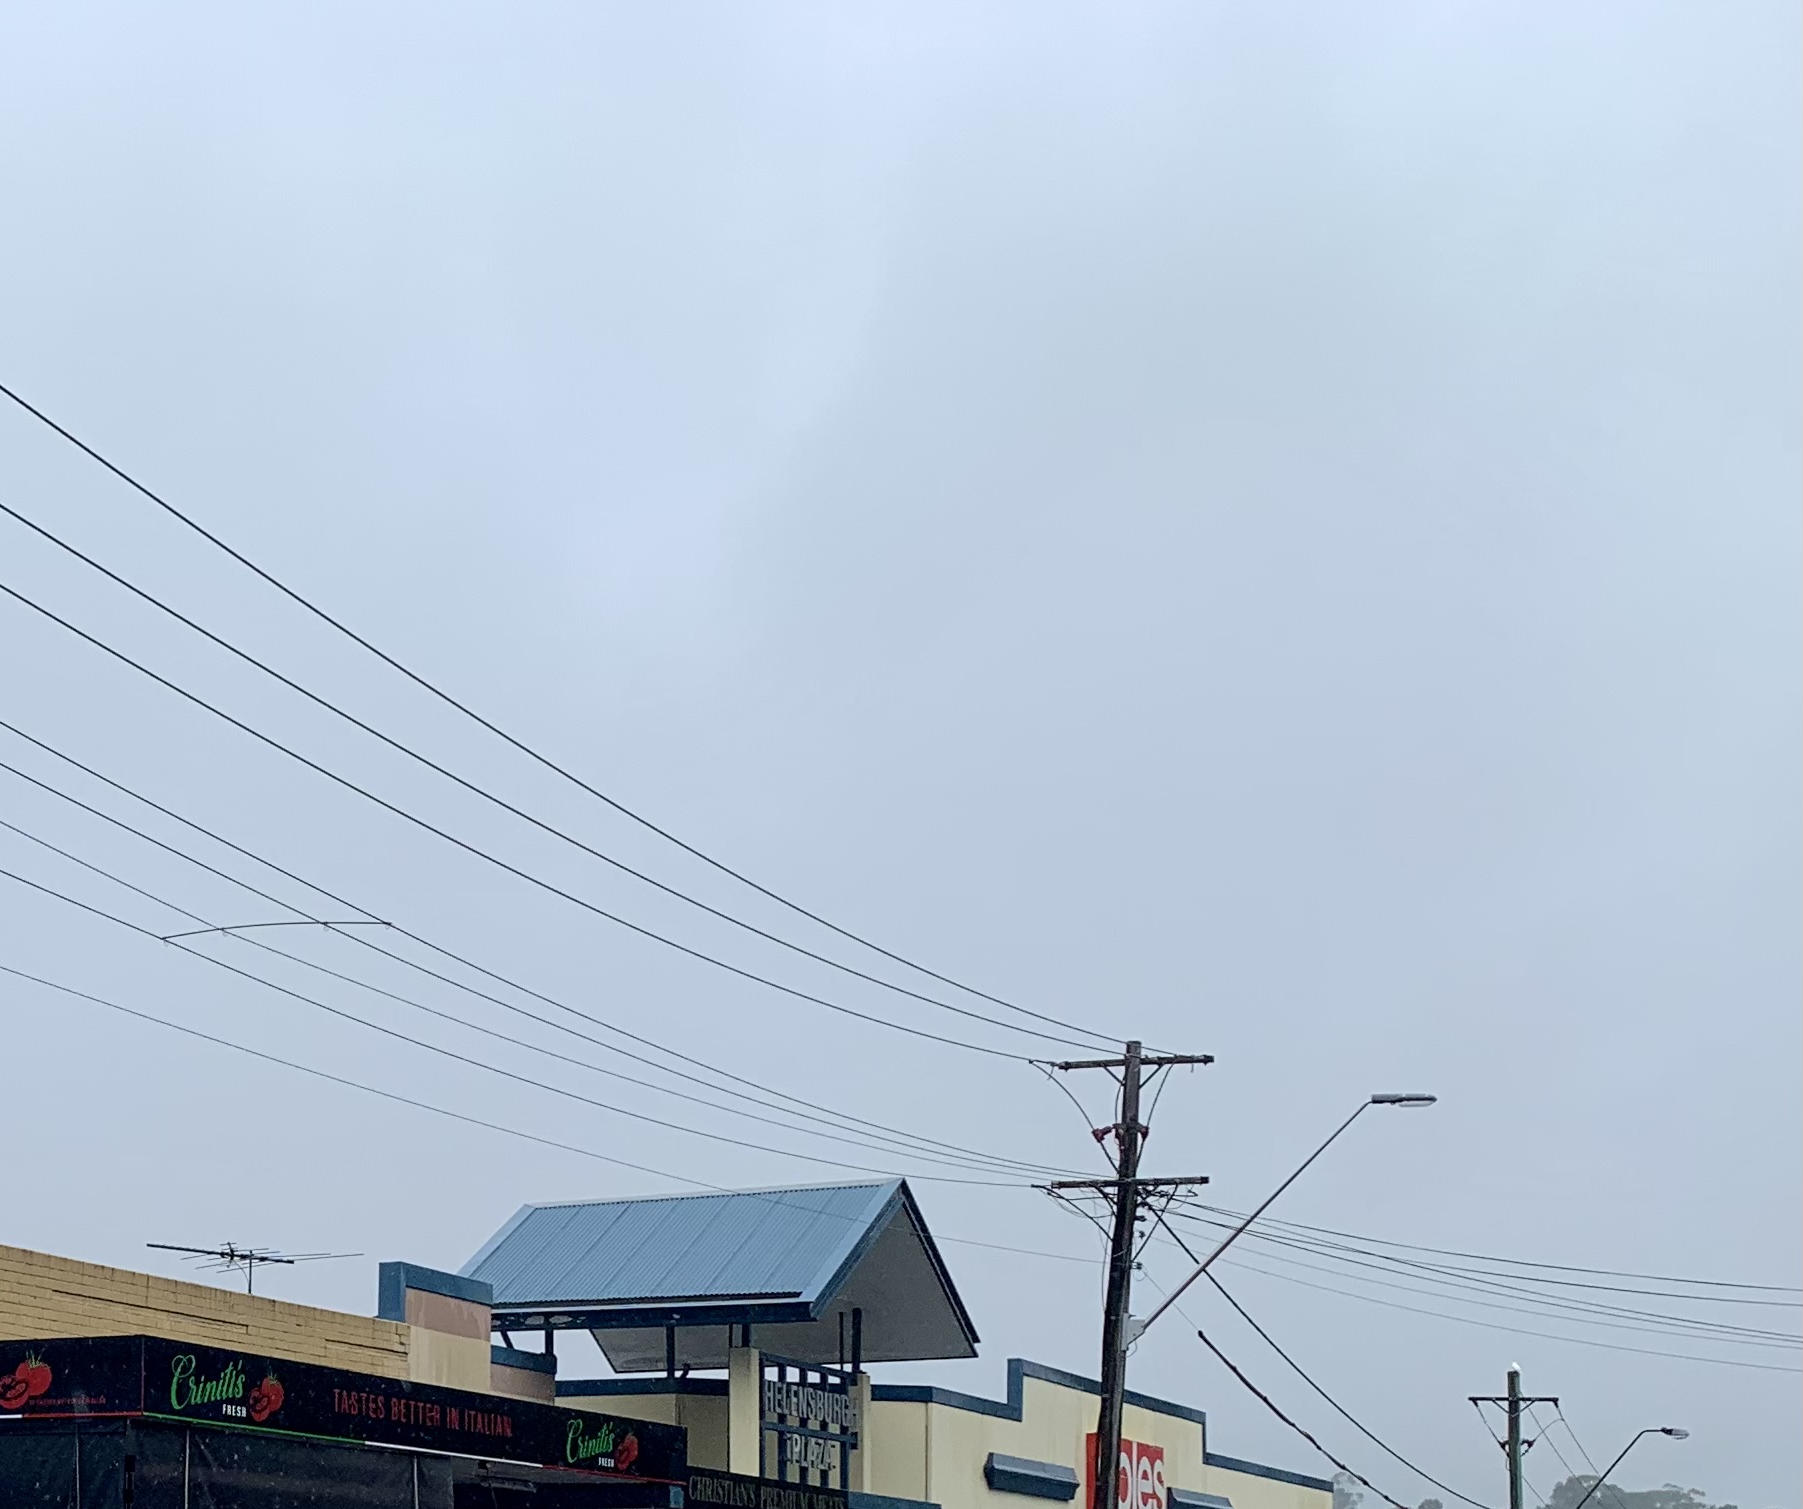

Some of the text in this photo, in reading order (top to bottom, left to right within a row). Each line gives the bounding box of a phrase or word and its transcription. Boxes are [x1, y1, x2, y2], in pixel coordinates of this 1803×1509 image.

[222, 1402, 248, 1418] FRESH
[332, 1388, 514, 1438] TASTES BETTER IN ITALIAN
[764, 1380, 860, 1432] HELENSBURGH
[688, 1474, 757, 1509] CHRISTIAN'S
